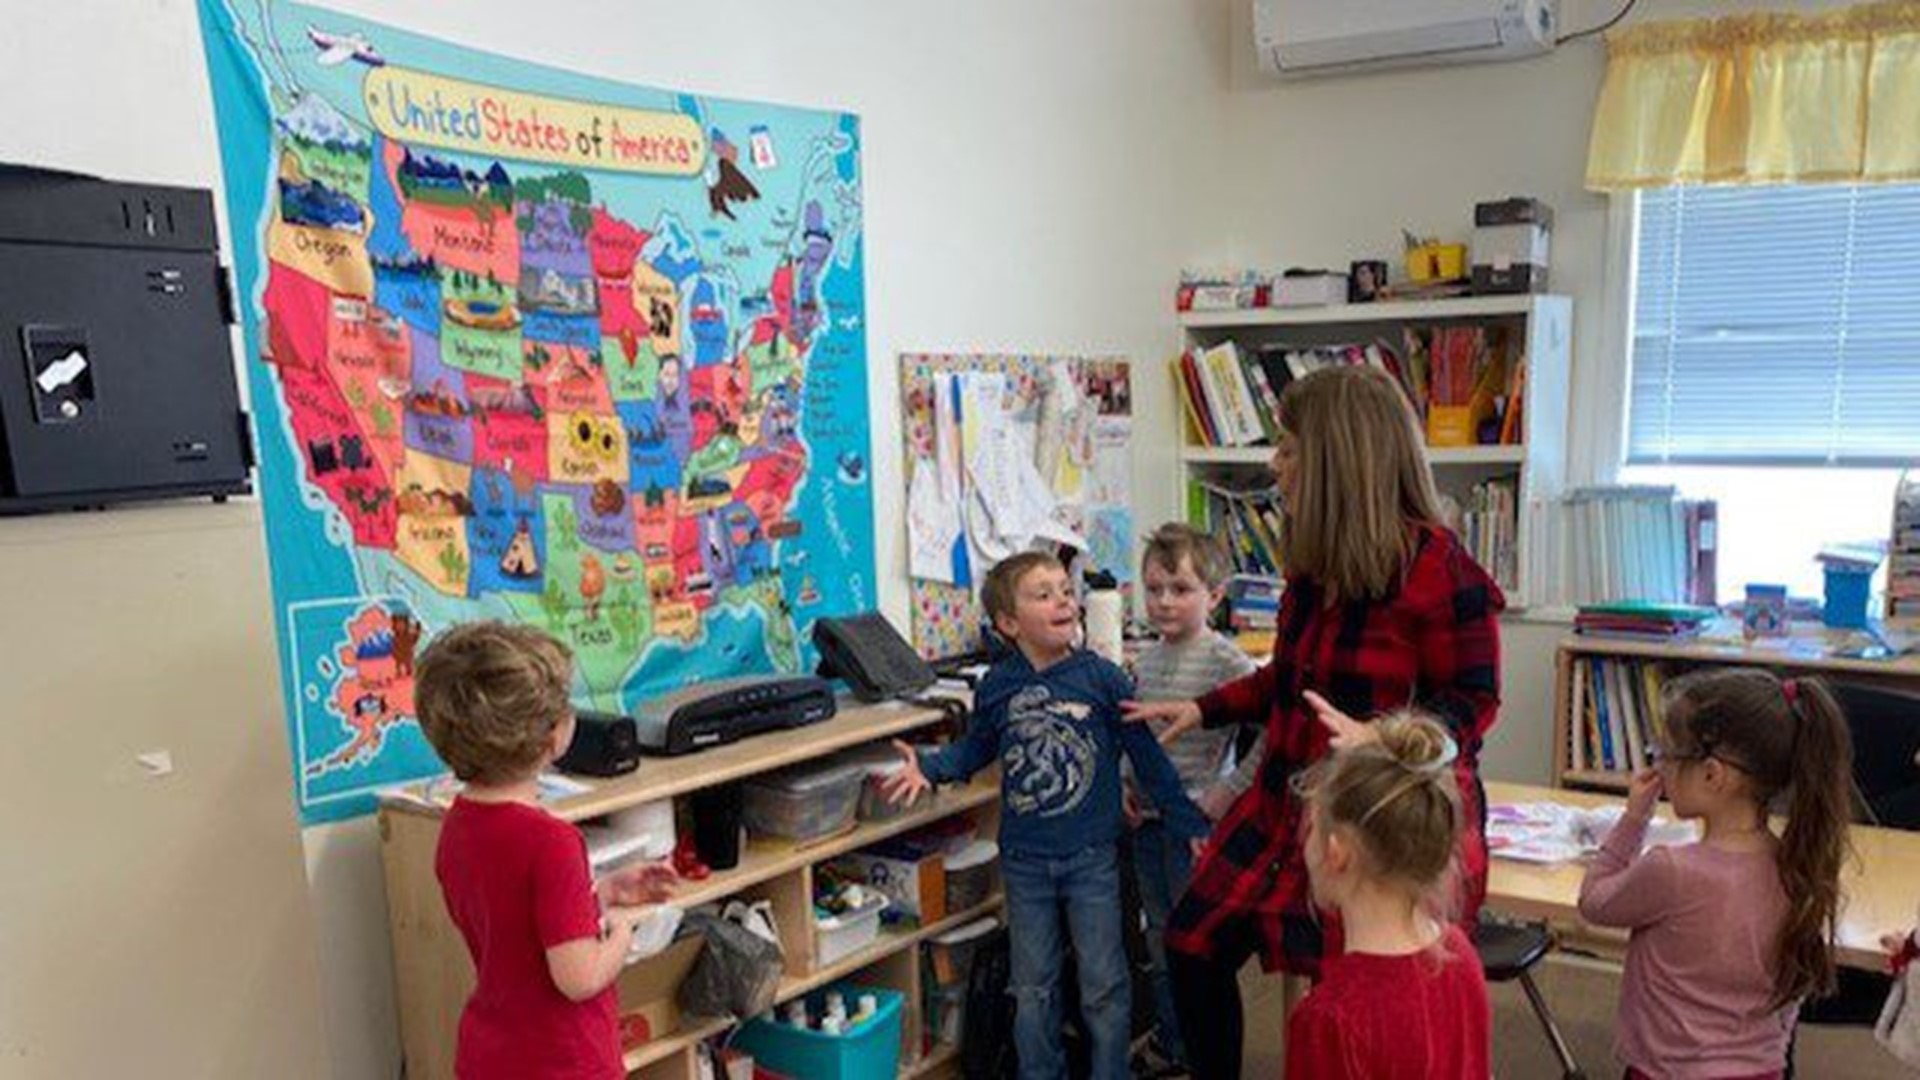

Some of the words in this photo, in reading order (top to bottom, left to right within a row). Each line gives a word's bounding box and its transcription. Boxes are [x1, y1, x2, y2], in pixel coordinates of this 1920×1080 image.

[386, 79, 480, 139] United
[481, 98, 570, 153] States
[576, 117, 603, 156] of
[610, 118, 689, 163] America
[295, 229, 352, 266] Oregon
[568, 622, 613, 647] Texas
